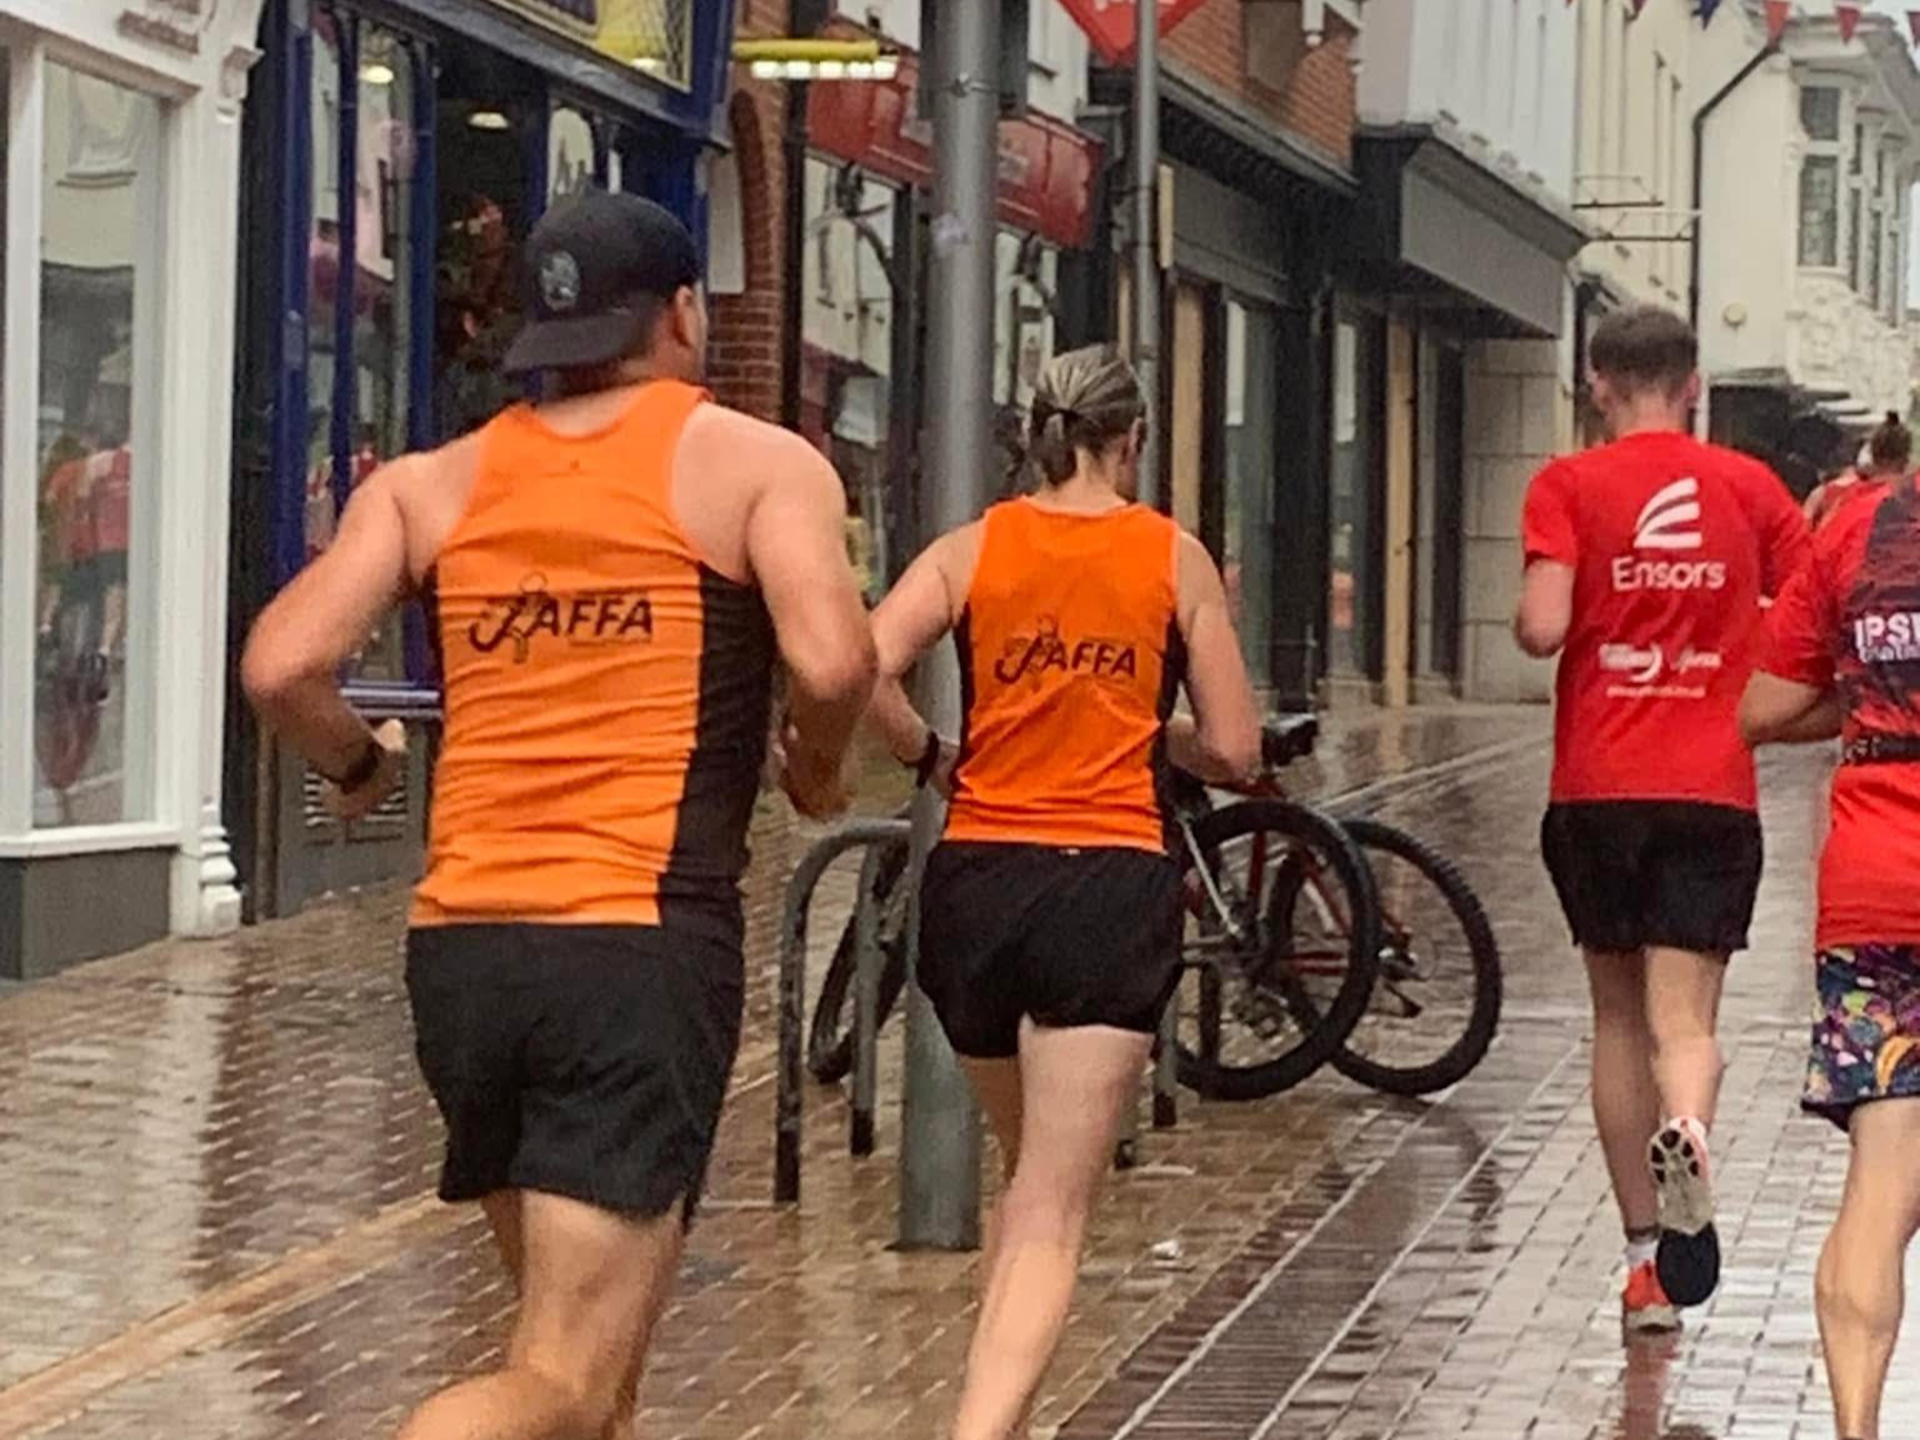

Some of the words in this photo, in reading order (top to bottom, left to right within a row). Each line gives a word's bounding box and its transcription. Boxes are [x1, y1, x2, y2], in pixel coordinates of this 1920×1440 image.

[1612, 556, 1727, 592] Ensors
[469, 595, 653, 653] JAFFA
[994, 636, 1136, 685] JAFFA
